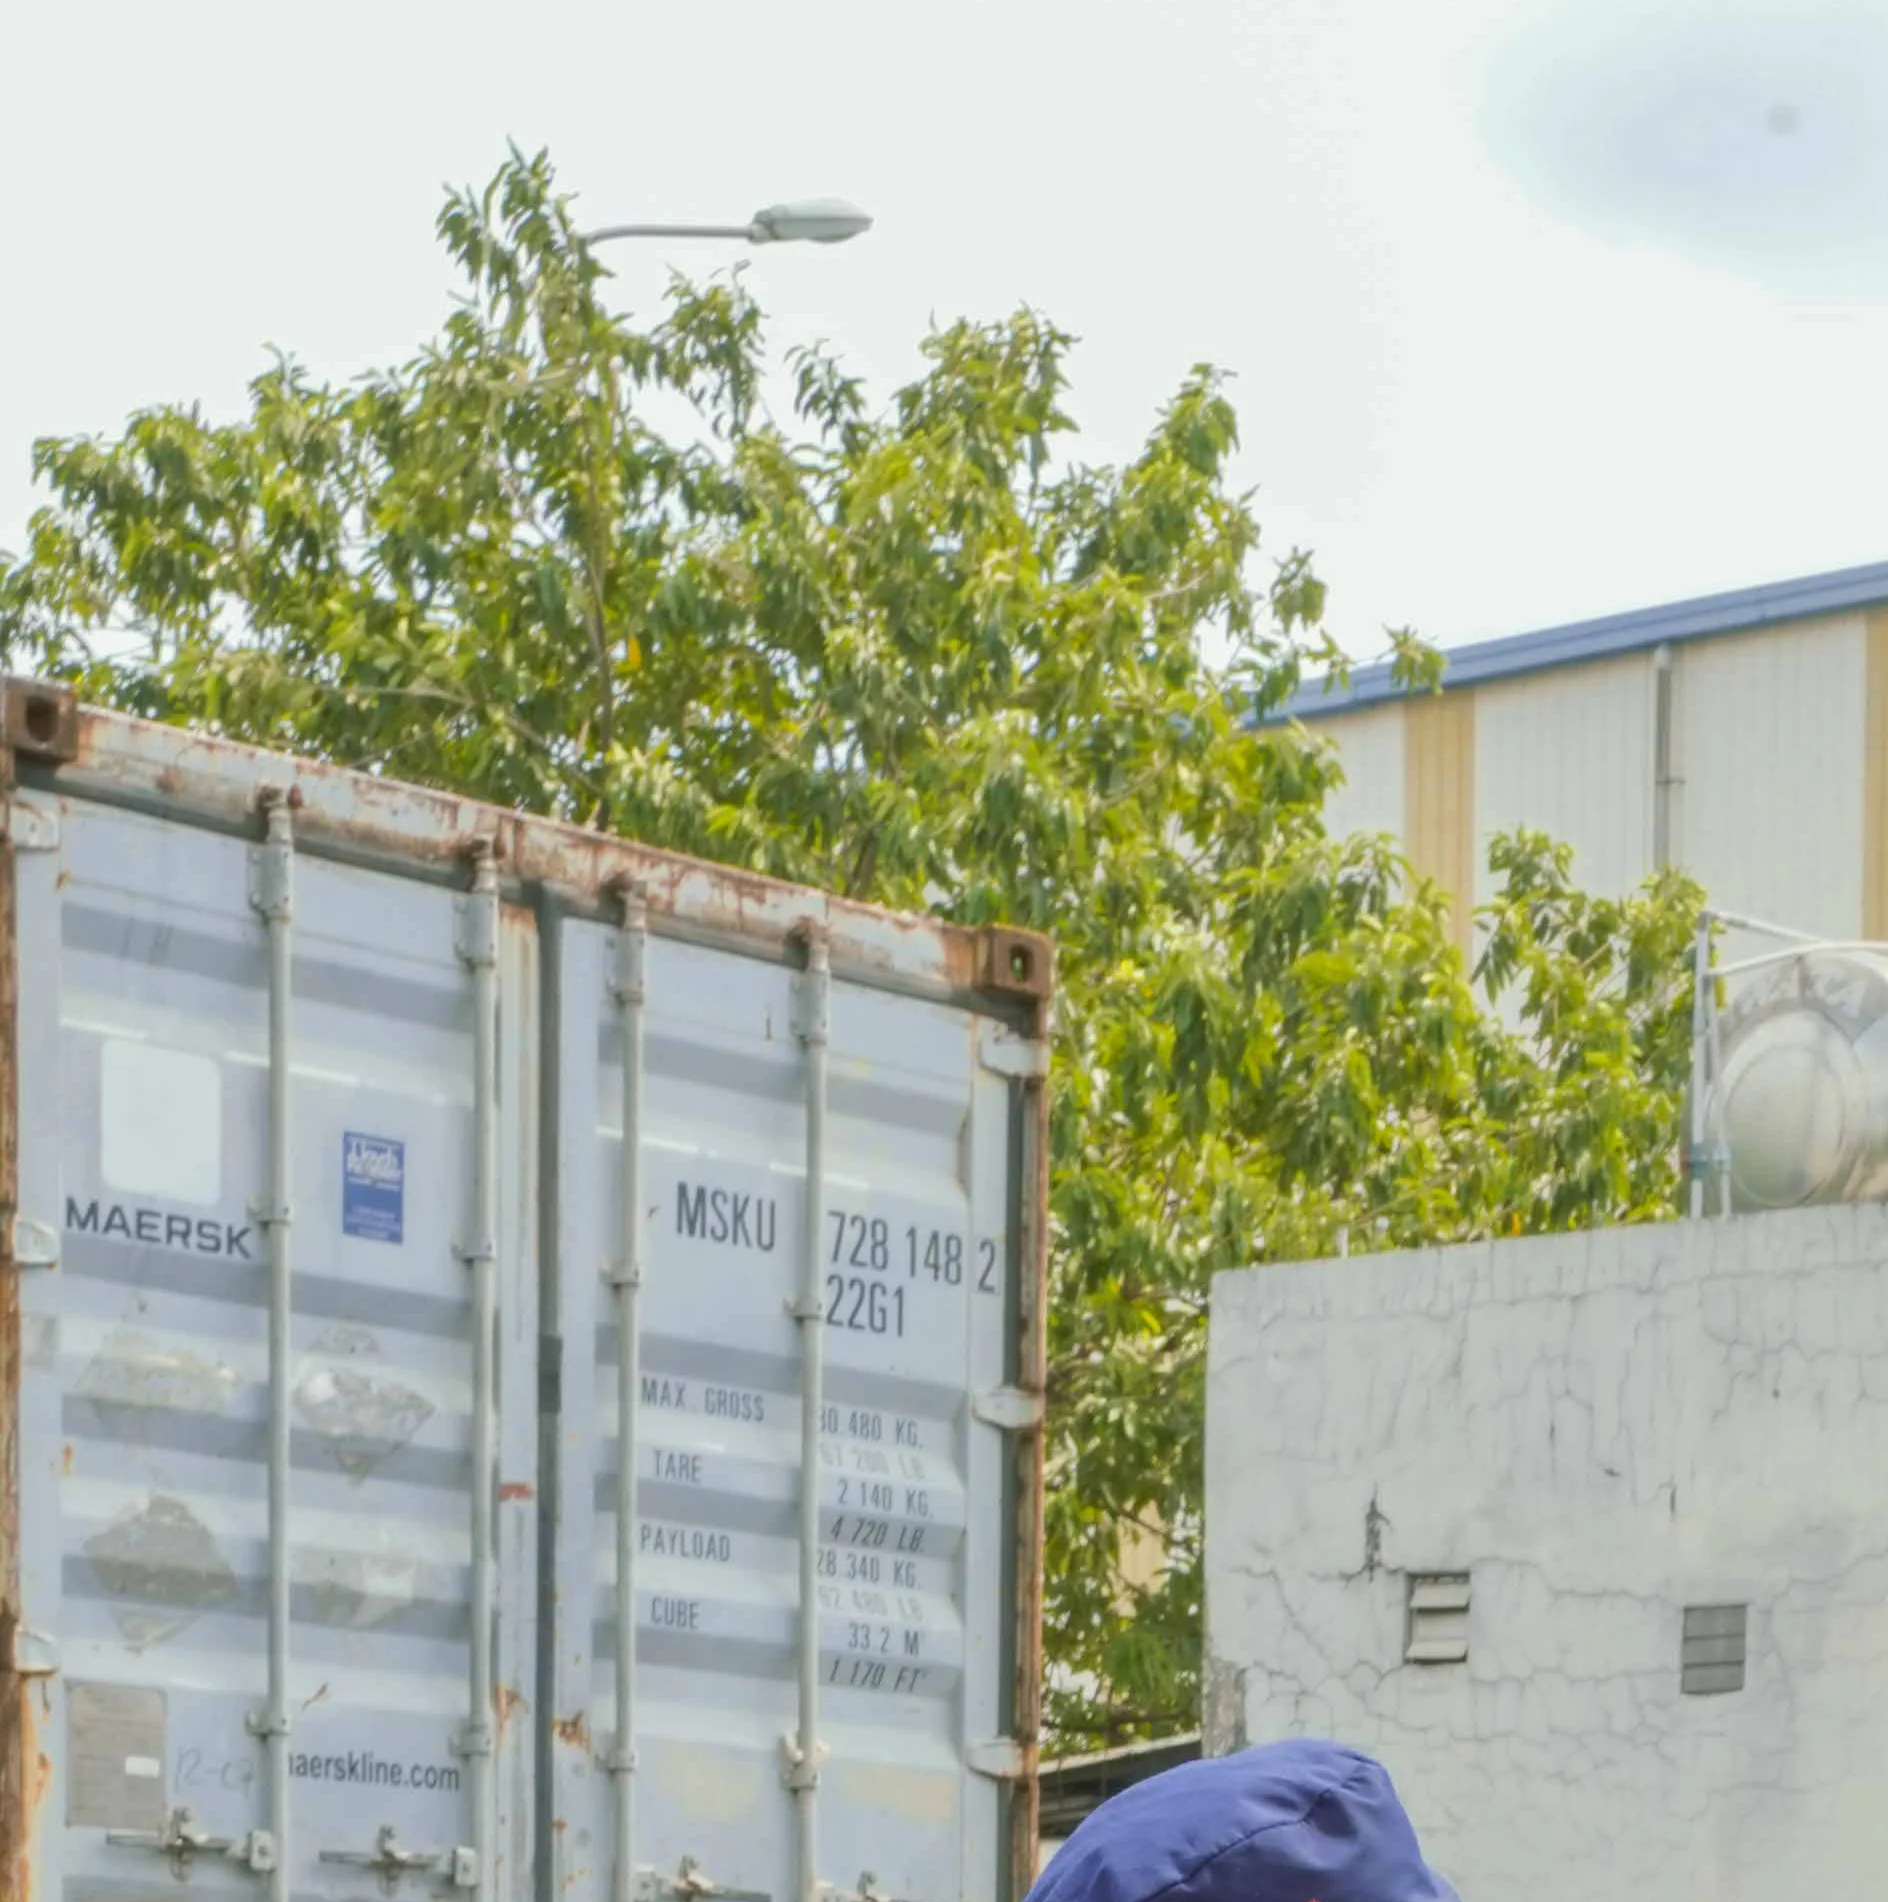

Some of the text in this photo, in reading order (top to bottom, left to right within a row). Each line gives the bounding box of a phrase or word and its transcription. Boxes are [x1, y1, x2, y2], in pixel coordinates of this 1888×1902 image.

[65, 1195, 252, 1260] MAERSK
[675, 1180, 998, 1294] MSKU 728 148 2
[825, 1273, 905, 1338] 22G1
[704, 1386, 766, 1423] GROSS
[849, 1410, 883, 1443] 480
[653, 1450, 703, 1484] TARE
[837, 1478, 849, 1507] 2
[859, 1480, 894, 1514] 140
[639, 1522, 732, 1563] PAYLOAD
[847, 1552, 881, 1583] 340
[830, 1514, 844, 1541] 4
[850, 1519, 890, 1549] 720
[651, 1596, 700, 1631] CUBE
[829, 1656, 842, 1685] 1
[850, 1659, 887, 1690] 170
[288, 1749, 461, 1792] aerskline.com
